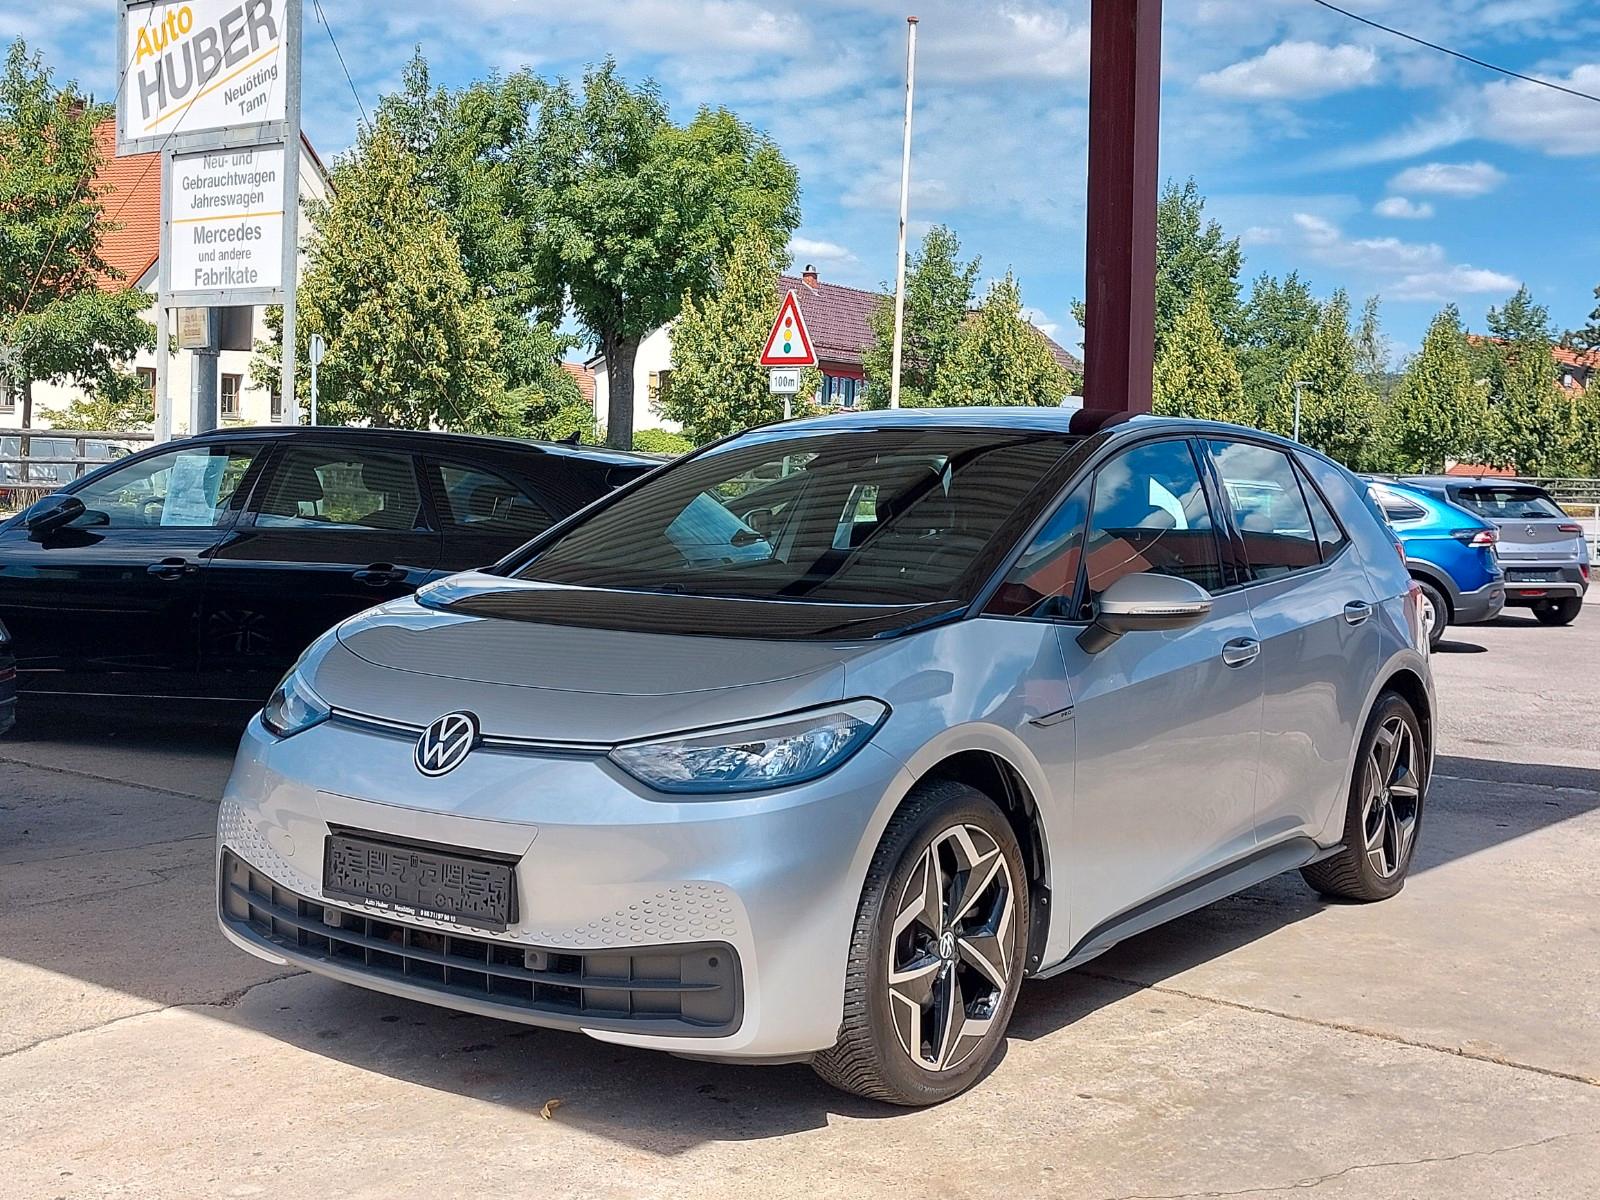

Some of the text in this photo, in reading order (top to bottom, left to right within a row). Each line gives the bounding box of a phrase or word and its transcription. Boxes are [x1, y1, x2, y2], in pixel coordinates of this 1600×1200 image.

[136, 5, 193, 64] Auto
[137, 0, 278, 120] HUBER
[224, 63, 278, 105] Neuötting
[238, 92, 267, 116] Tann
[203, 152, 253, 170] Neu- und
[182, 170, 276, 190] Gebrauchtwagen
[190, 191, 264, 209] Jahreswagen
[193, 222, 262, 245] Mercedes
[198, 247, 252, 262] und andere
[194, 266, 258, 287] Fabrikate
